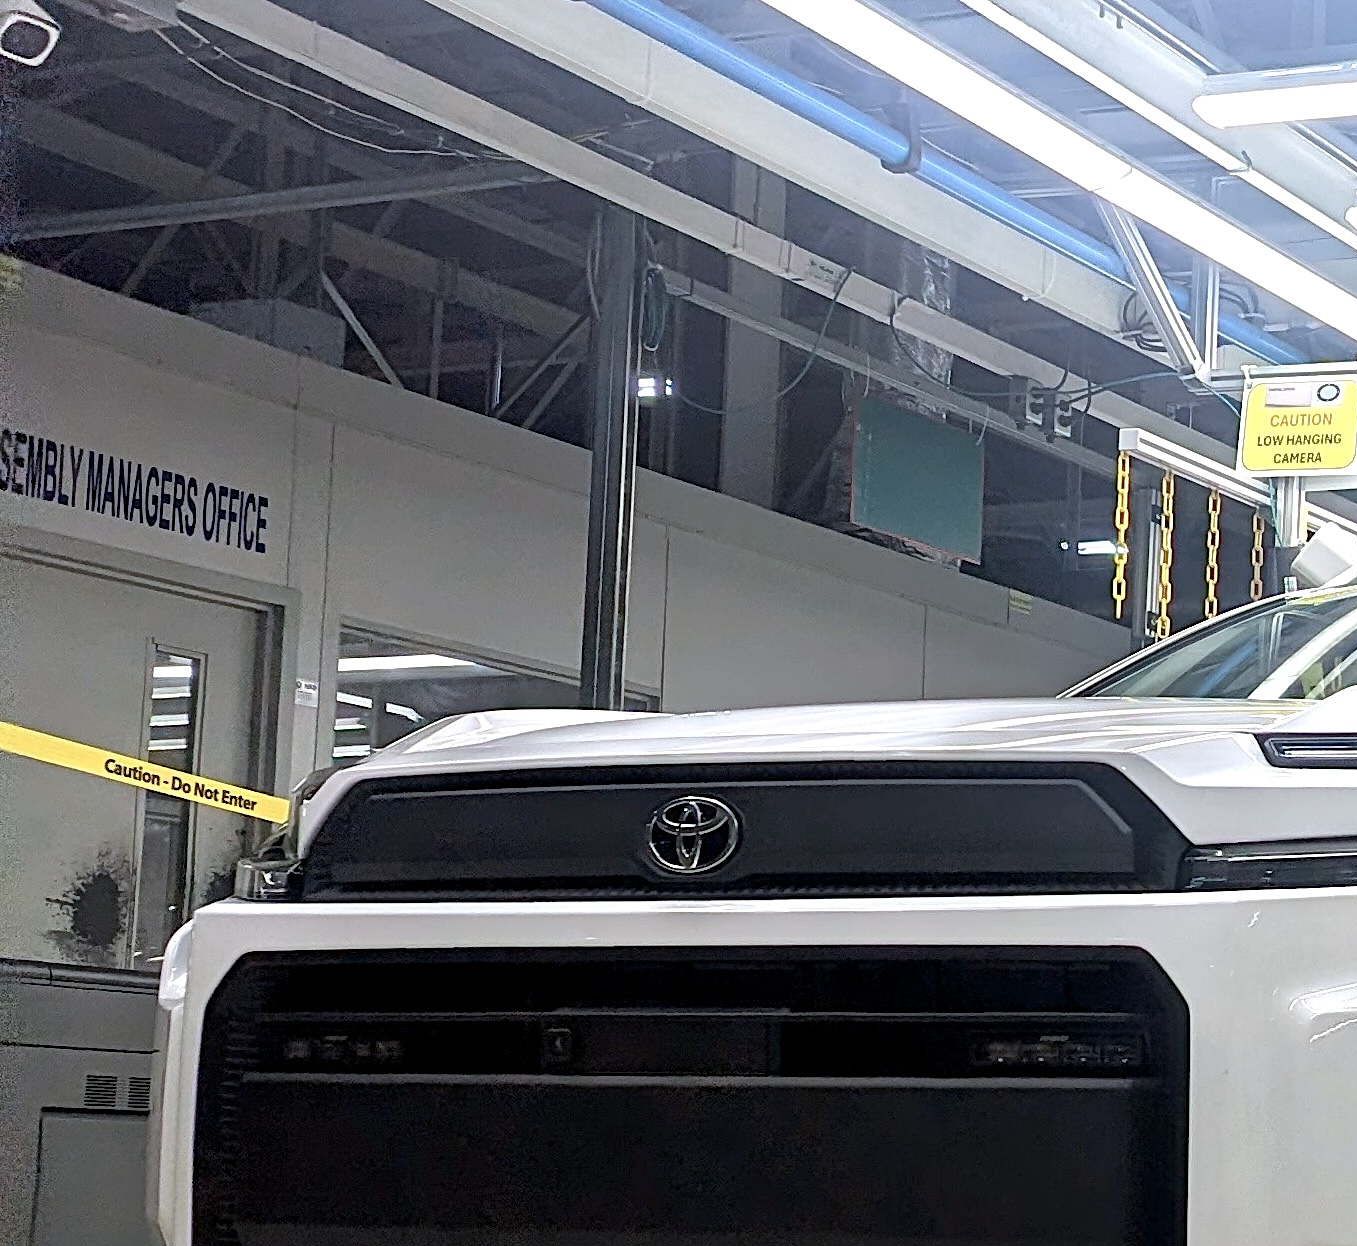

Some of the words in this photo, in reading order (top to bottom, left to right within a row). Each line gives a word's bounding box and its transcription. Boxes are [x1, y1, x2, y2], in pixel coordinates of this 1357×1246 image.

[1270, 413, 1333, 427] CAUTION
[1257, 435, 1284, 447] LOW
[1286, 433, 1342, 446] HANGING
[1273, 452, 1322, 464] CAMERA
[86, 450, 198, 537] MANAGERS
[202, 482, 269, 553] OFFICE
[104, 758, 160, 786] Caution
[171, 776, 191, 793] Do
[194, 782, 219, 802] Not
[221, 789, 257, 811] Enter
